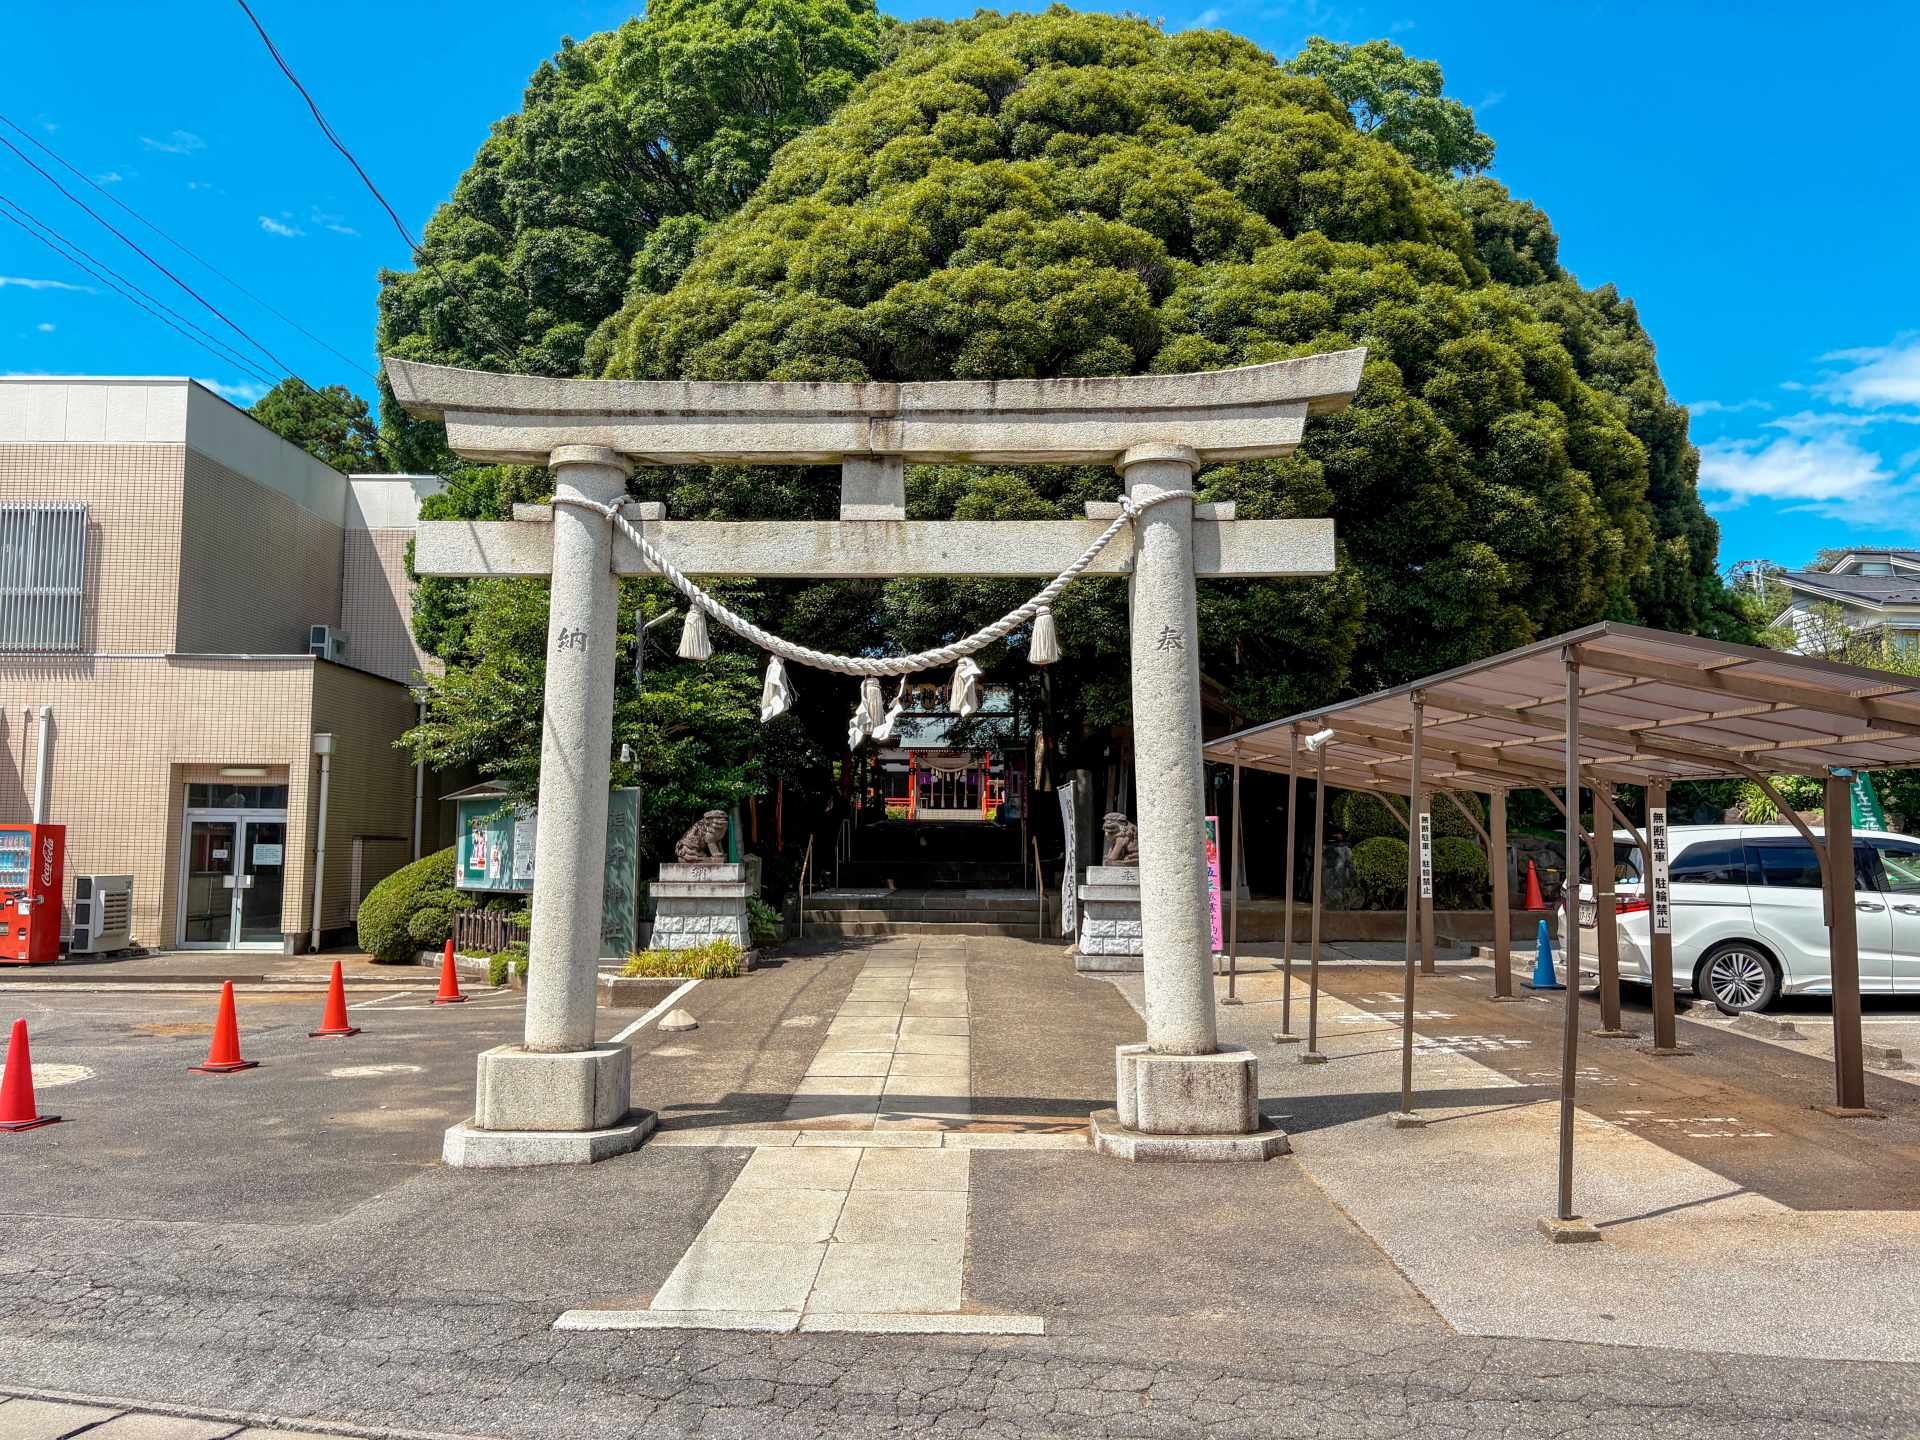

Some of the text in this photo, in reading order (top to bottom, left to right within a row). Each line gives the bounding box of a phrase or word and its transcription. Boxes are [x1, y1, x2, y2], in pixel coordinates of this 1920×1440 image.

[557, 627, 588, 652] 納
[1157, 625, 1185, 653] 奉
[41, 834, 54, 887] Coca-Cola
[1652, 812, 1669, 929] 無断駐車・駐輪禁止
